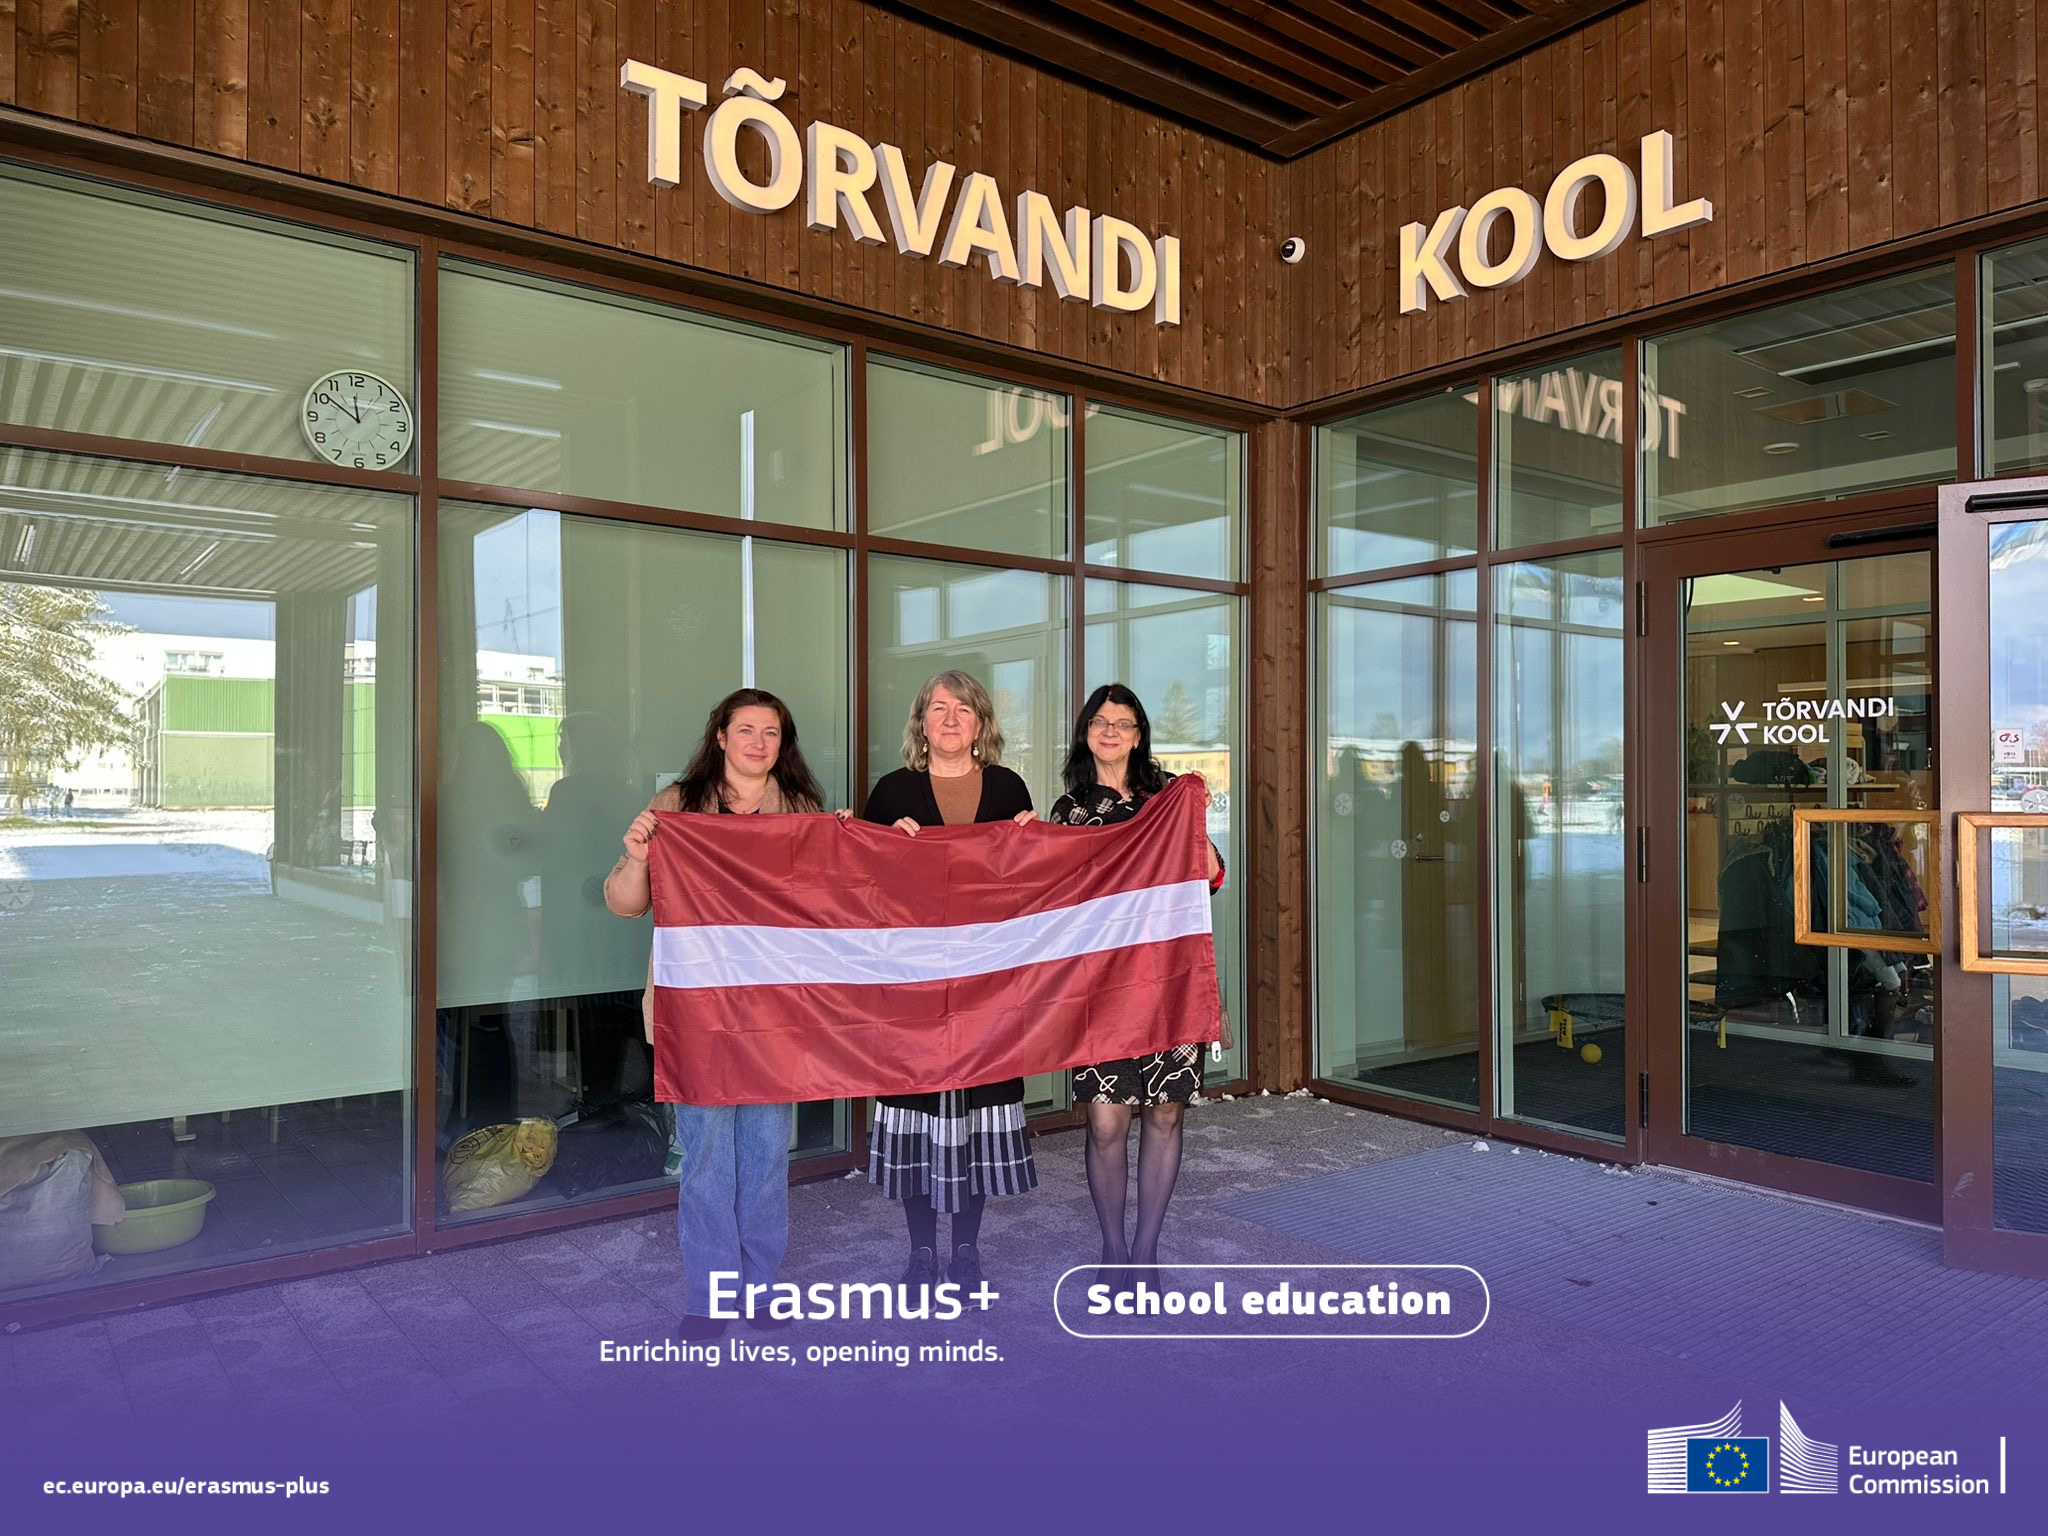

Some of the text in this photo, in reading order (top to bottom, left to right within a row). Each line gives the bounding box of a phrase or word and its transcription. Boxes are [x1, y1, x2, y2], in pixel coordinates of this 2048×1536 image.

[620, 58, 1181, 328] TÕRVANDI
[1399, 129, 1713, 315] KOOL
[328, 379, 339, 392] 11
[348, 375, 365, 388] 12
[377, 385, 383, 397] 1
[313, 392, 330, 405] 10
[389, 401, 400, 412] 2
[307, 411, 319, 422] 9
[396, 421, 407, 433] 3
[314, 432, 326, 444] 8
[389, 441, 400, 453] 4
[331, 449, 342, 461] 7
[376, 453, 386, 465] 5
[353, 457, 365, 469] 6
[1762, 696, 1894, 721] TÕRVANDI
[1763, 723, 1830, 745] KOOL
